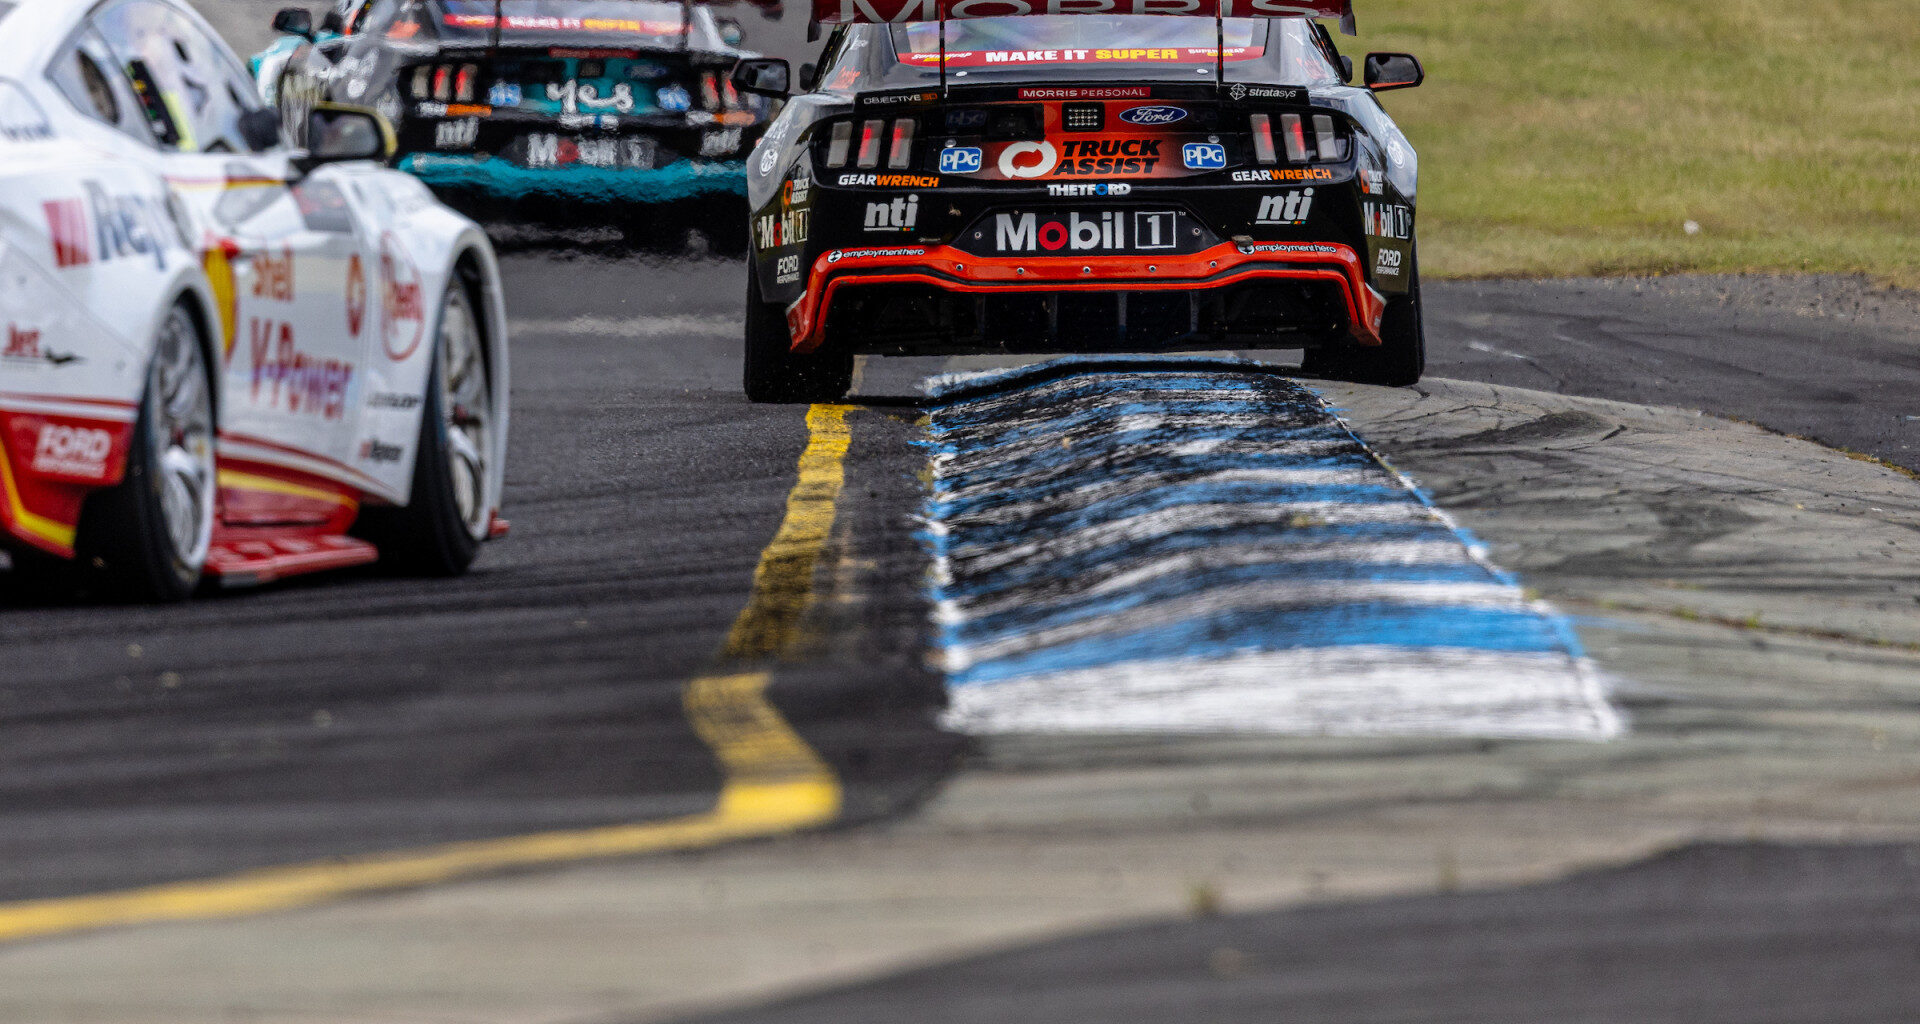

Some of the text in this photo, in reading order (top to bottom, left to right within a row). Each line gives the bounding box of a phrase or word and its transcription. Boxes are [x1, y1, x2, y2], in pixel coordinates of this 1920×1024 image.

[985, 49, 1179, 63] MAKE IT SUPER
[1023, 88, 1146, 98] MORRIS PERSONAL
[1248, 87, 1297, 99] stratasys
[1131, 107, 1175, 123] Ford
[1063, 139, 1163, 157] TRUCK
[1186, 146, 1223, 165] PPG
[942, 150, 979, 170] PPG
[1053, 157, 1160, 175] ASSIST
[838, 174, 940, 187] GEARWRENCH
[1231, 168, 1332, 181] GEARWRENCH
[1047, 183, 1132, 196] THETFORD
[864, 194, 919, 227] nti
[1256, 187, 1314, 220] nti
[1364, 202, 1394, 238] Mobil
[761, 210, 795, 249] Mobil
[996, 211, 1124, 250] Mobil
[843, 248, 925, 259] employmenthero
[1255, 243, 1337, 253] employmenthero
[777, 254, 799, 275] FORD
[1377, 248, 1402, 267] FORD
[35, 423, 112, 462] FORD
